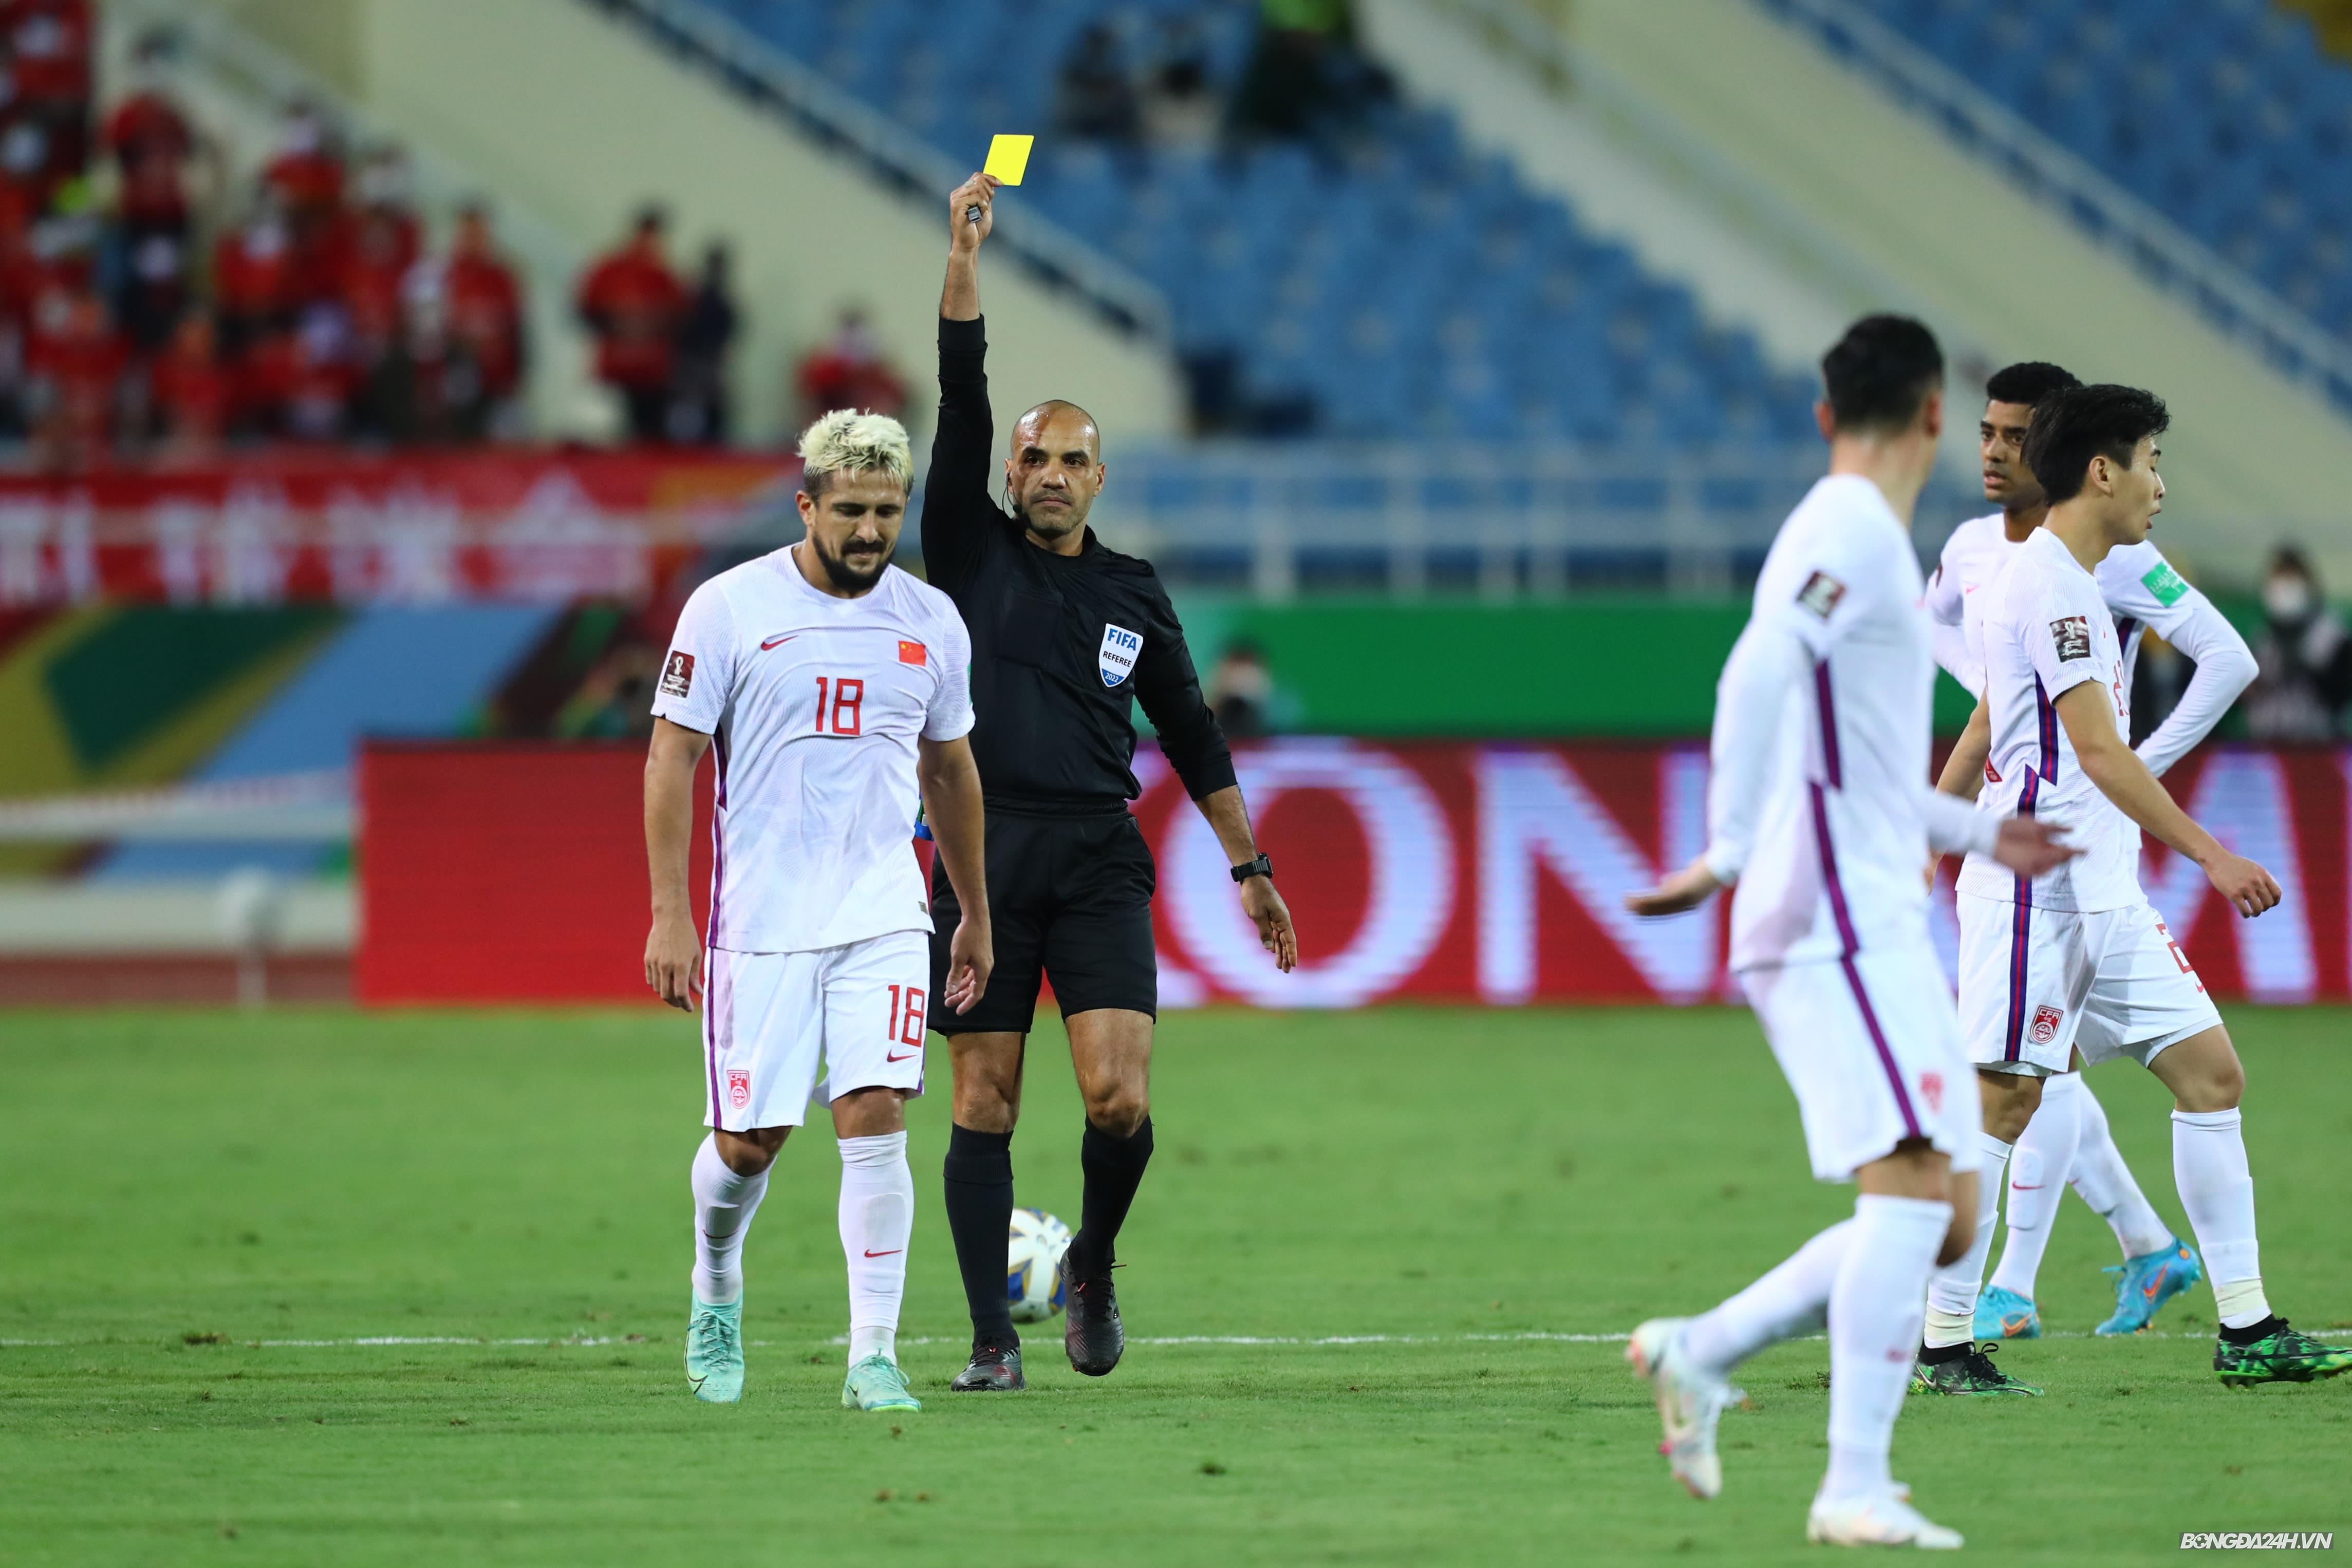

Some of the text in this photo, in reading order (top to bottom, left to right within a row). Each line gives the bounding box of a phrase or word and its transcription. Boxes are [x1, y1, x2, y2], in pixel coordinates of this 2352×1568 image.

[1107, 628, 1137, 651] FIFA
[1103, 650, 1132, 667] REFEREE
[1105, 673, 1119, 683] 2022
[816, 677, 864, 736] 18
[888, 984, 925, 1048] 18
[2039, 1009, 2060, 1020] CFA
